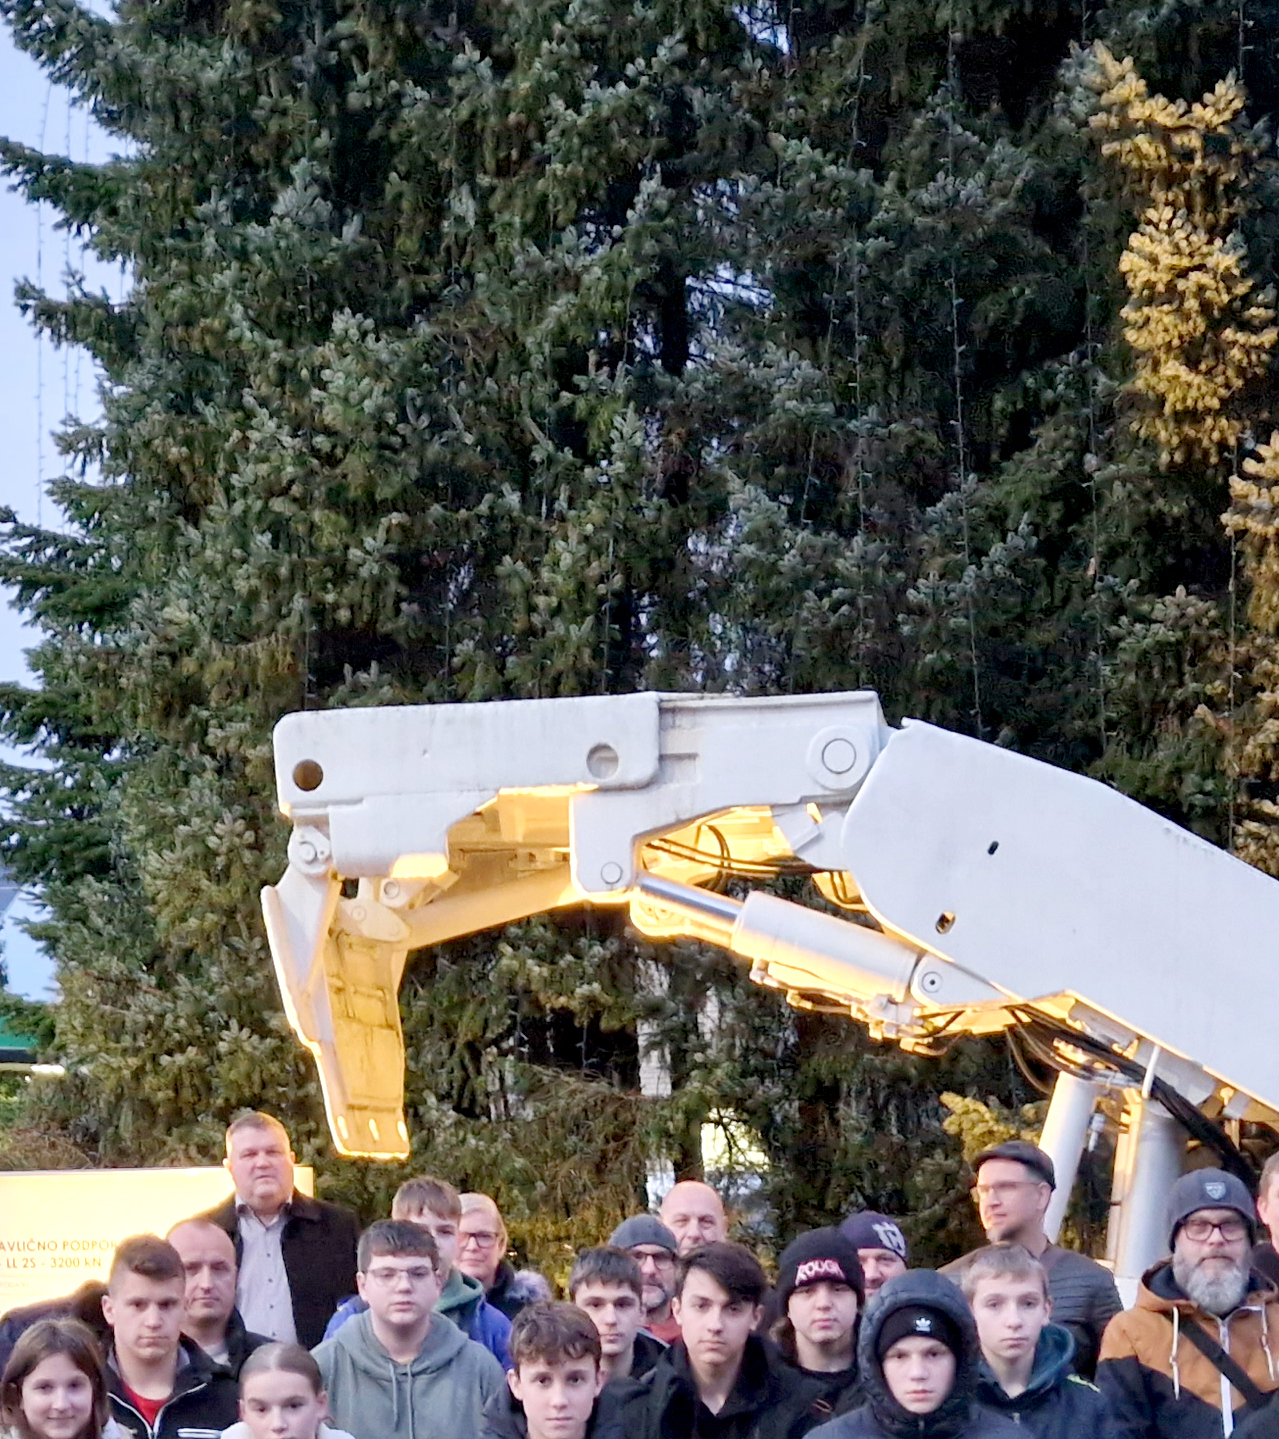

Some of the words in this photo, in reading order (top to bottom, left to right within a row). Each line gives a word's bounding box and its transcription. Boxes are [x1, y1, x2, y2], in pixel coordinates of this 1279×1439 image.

[7, 1257, 18, 1269] LL
[22, 1257, 36, 1268] 2S
[50, 1257, 80, 1268] 3200
[84, 1257, 102, 1268] kN
